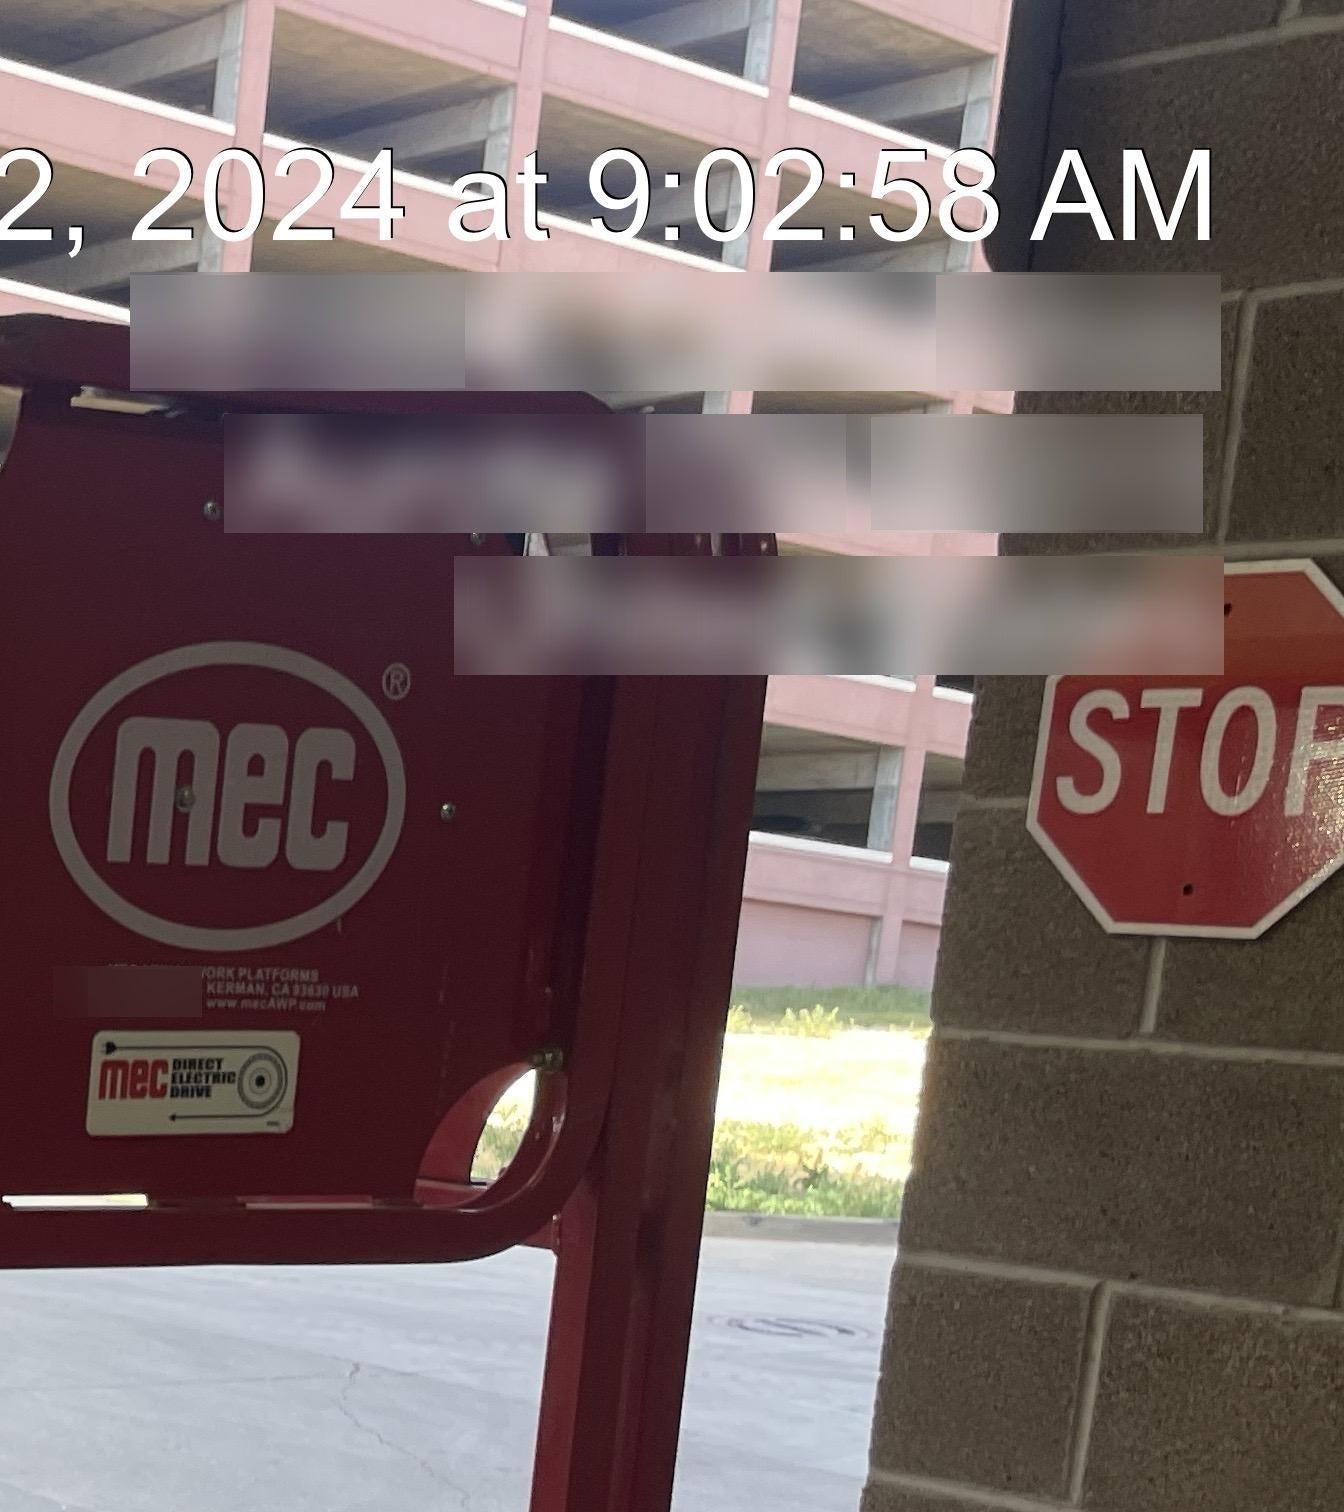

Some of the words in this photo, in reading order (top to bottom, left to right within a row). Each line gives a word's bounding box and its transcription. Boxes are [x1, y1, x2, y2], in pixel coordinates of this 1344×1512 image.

[238, 968, 319, 983] PLATFORMS
[271, 984, 290, 995] CA
[332, 985, 359, 998] USA
[173, 1058, 223, 1071] DIRECT
[171, 1071, 236, 1085] ELECTRIC
[170, 1085, 213, 1099] DRIVE
